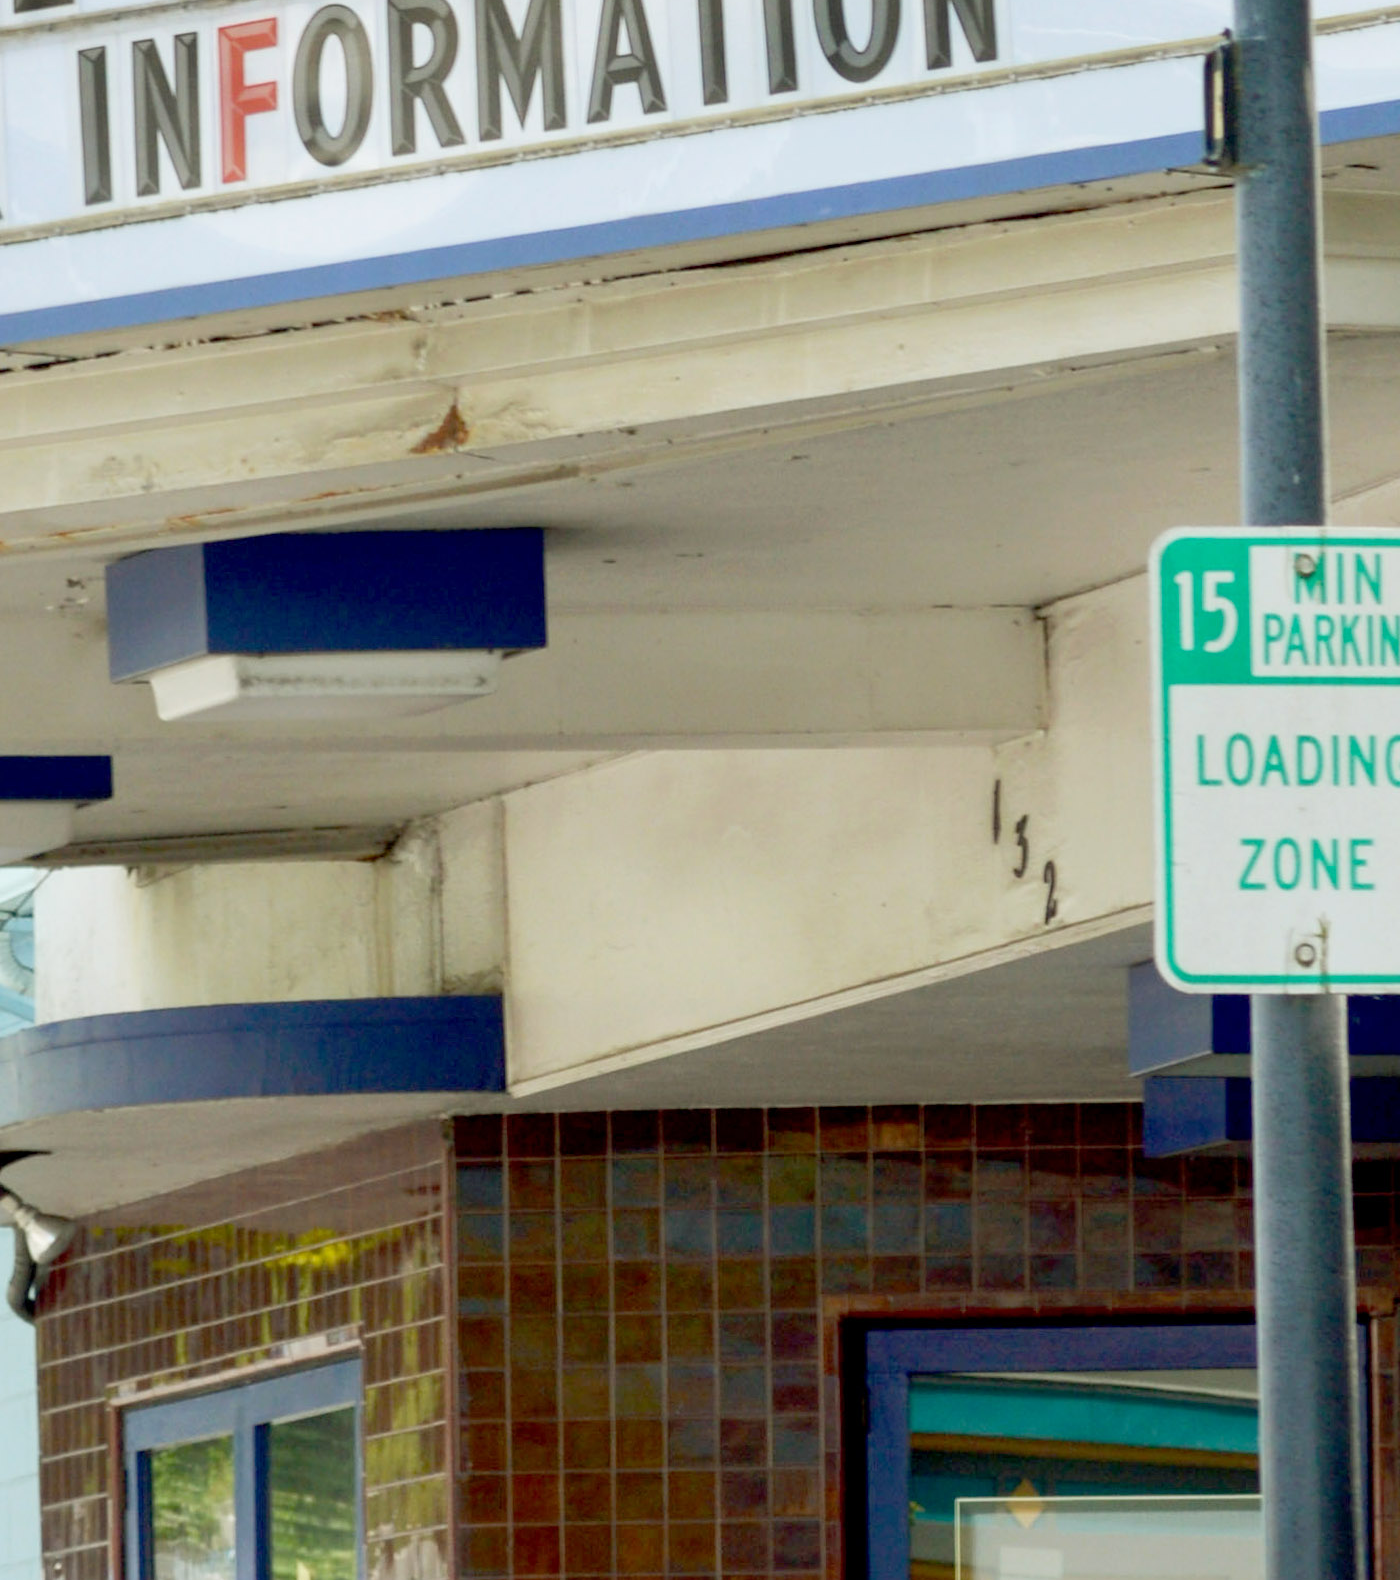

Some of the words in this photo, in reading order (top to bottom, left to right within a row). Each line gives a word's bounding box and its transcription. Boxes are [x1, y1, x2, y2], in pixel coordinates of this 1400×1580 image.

[1173, 569, 1239, 653] 15
[1292, 552, 1384, 605] MIN
[1237, 836, 1376, 892] ZONE
